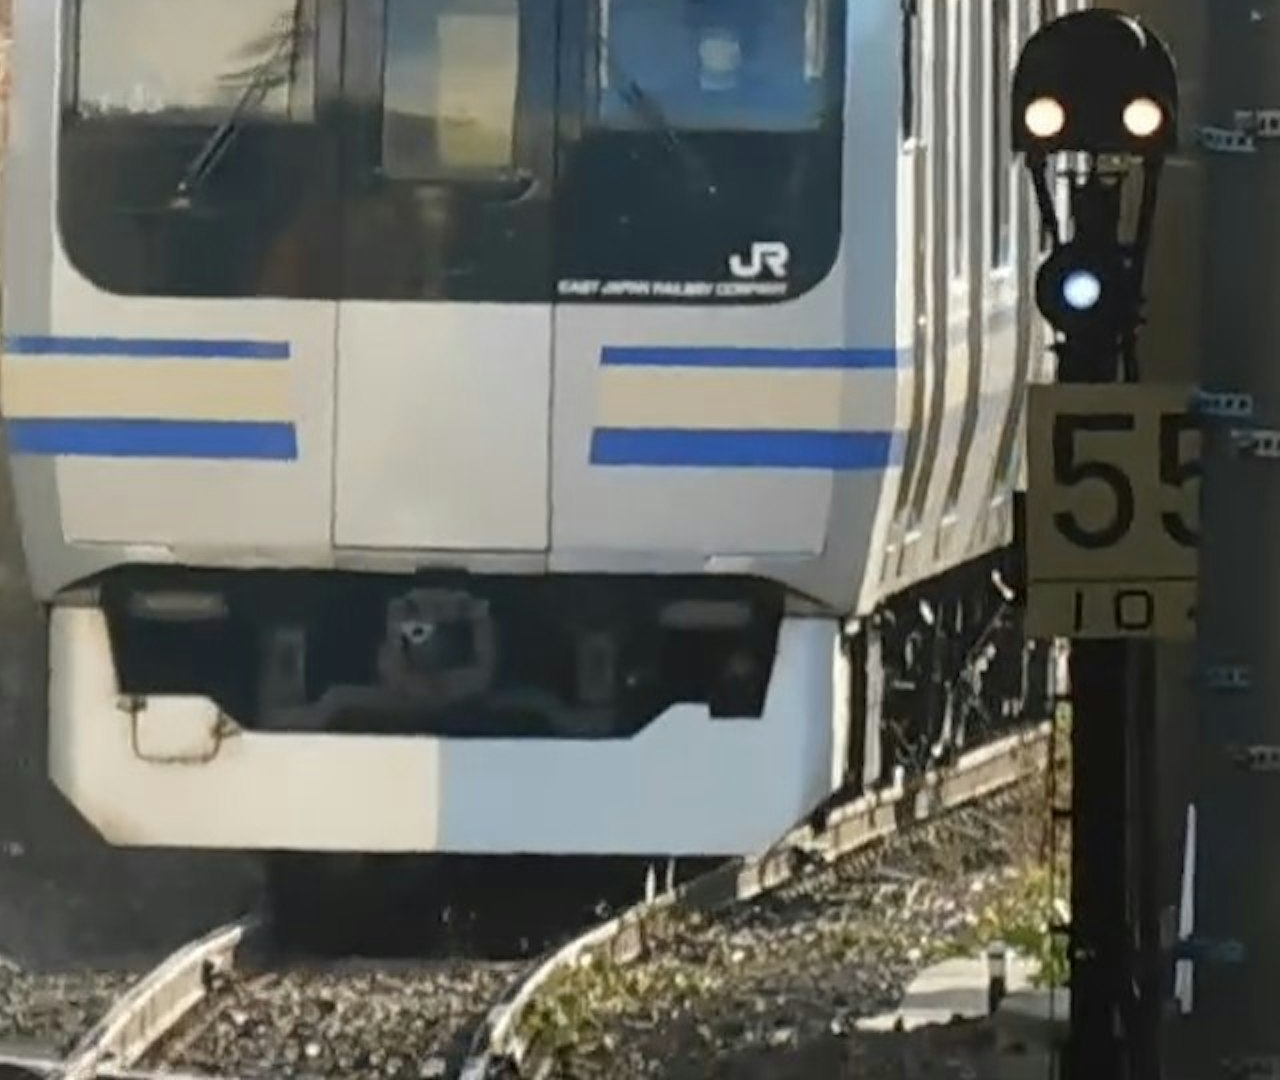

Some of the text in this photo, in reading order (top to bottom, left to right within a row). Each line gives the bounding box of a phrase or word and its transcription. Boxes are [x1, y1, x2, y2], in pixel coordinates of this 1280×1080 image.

[728, 241, 789, 278] JR
[557, 278, 787, 297] EAST JAPAN RAILWAY COMPANY
